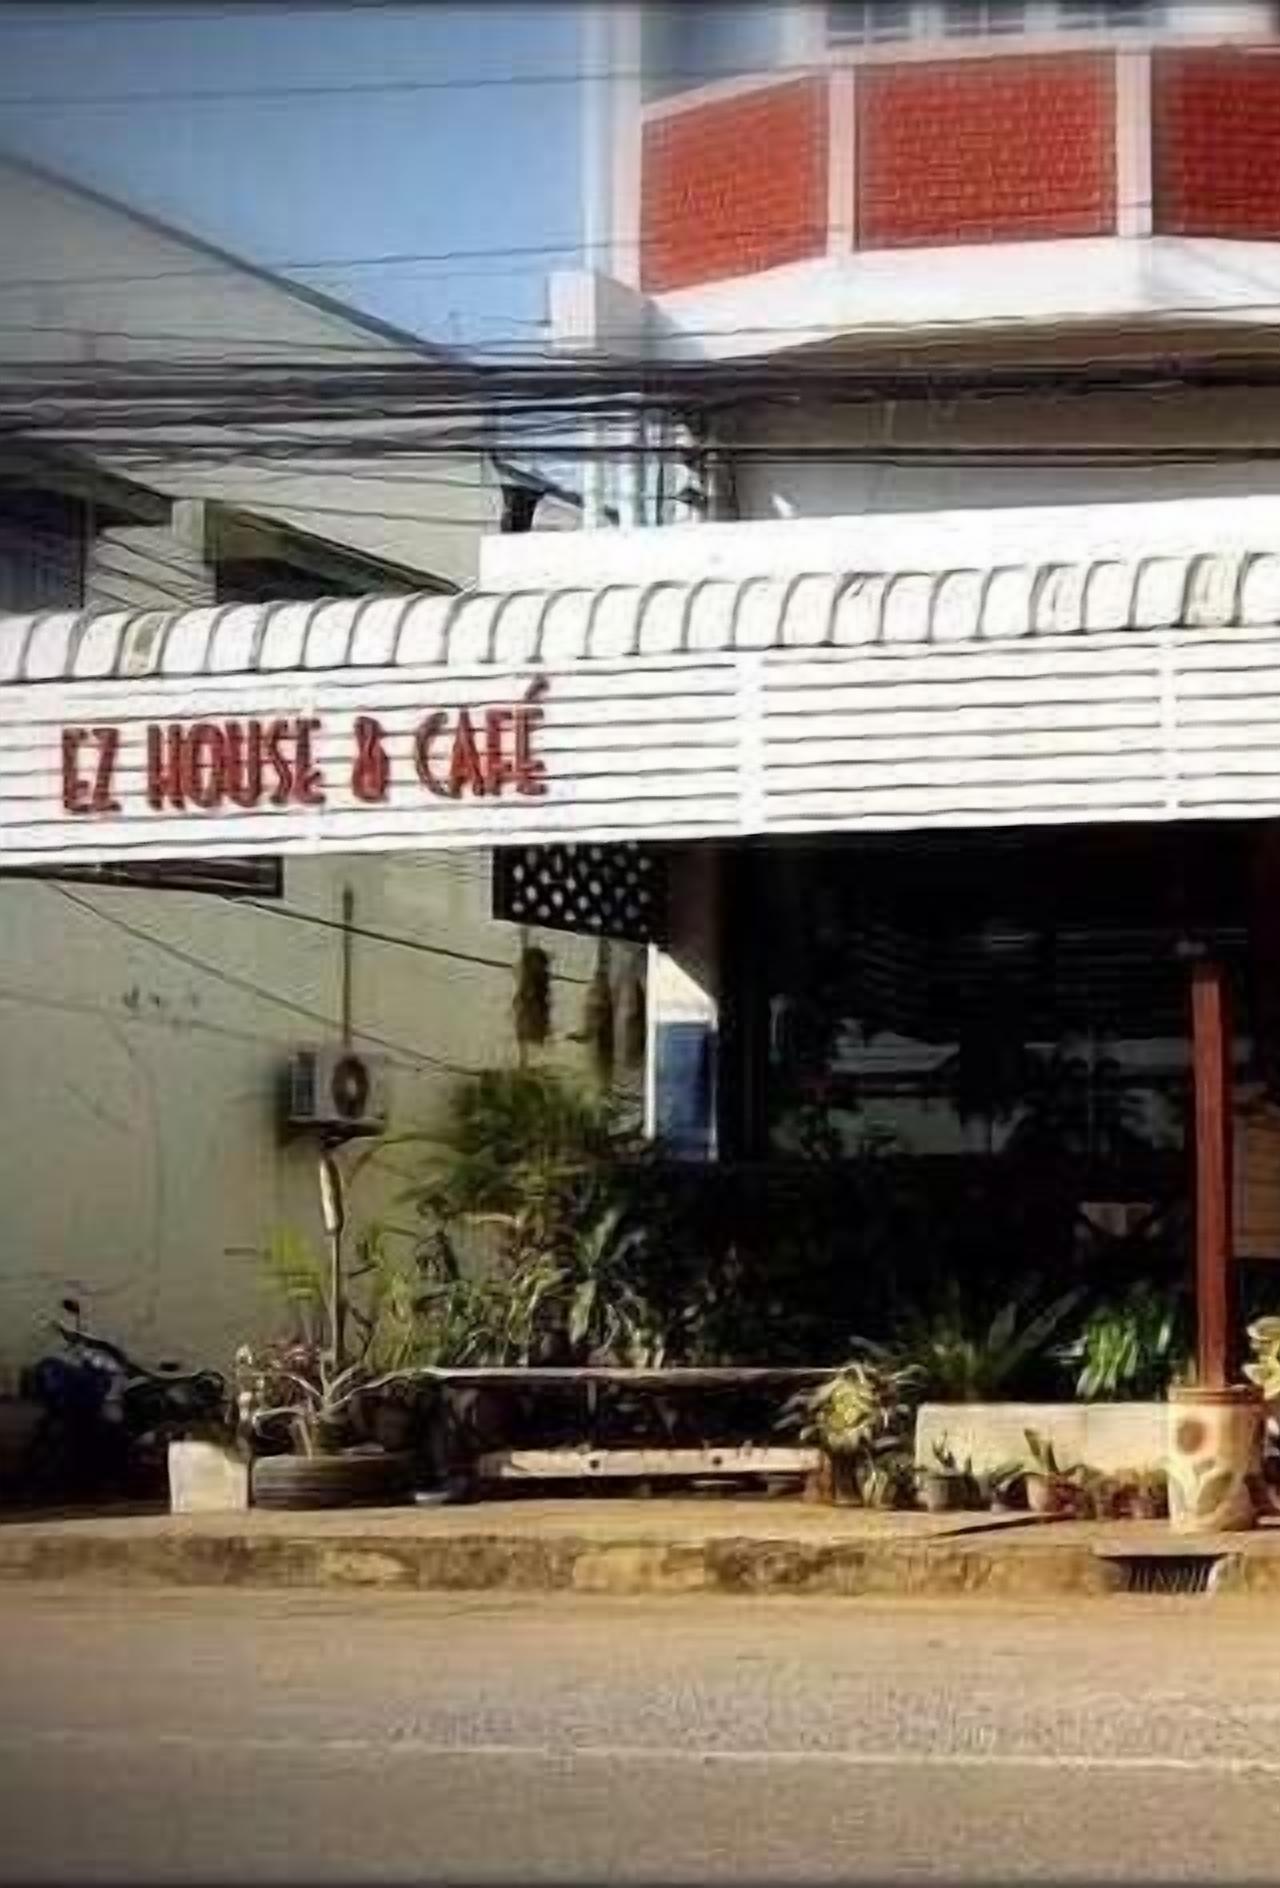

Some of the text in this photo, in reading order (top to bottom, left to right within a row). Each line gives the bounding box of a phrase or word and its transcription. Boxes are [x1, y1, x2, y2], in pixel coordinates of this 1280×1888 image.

[61, 674, 550, 814] EZ HOUSE & CAFÉ
